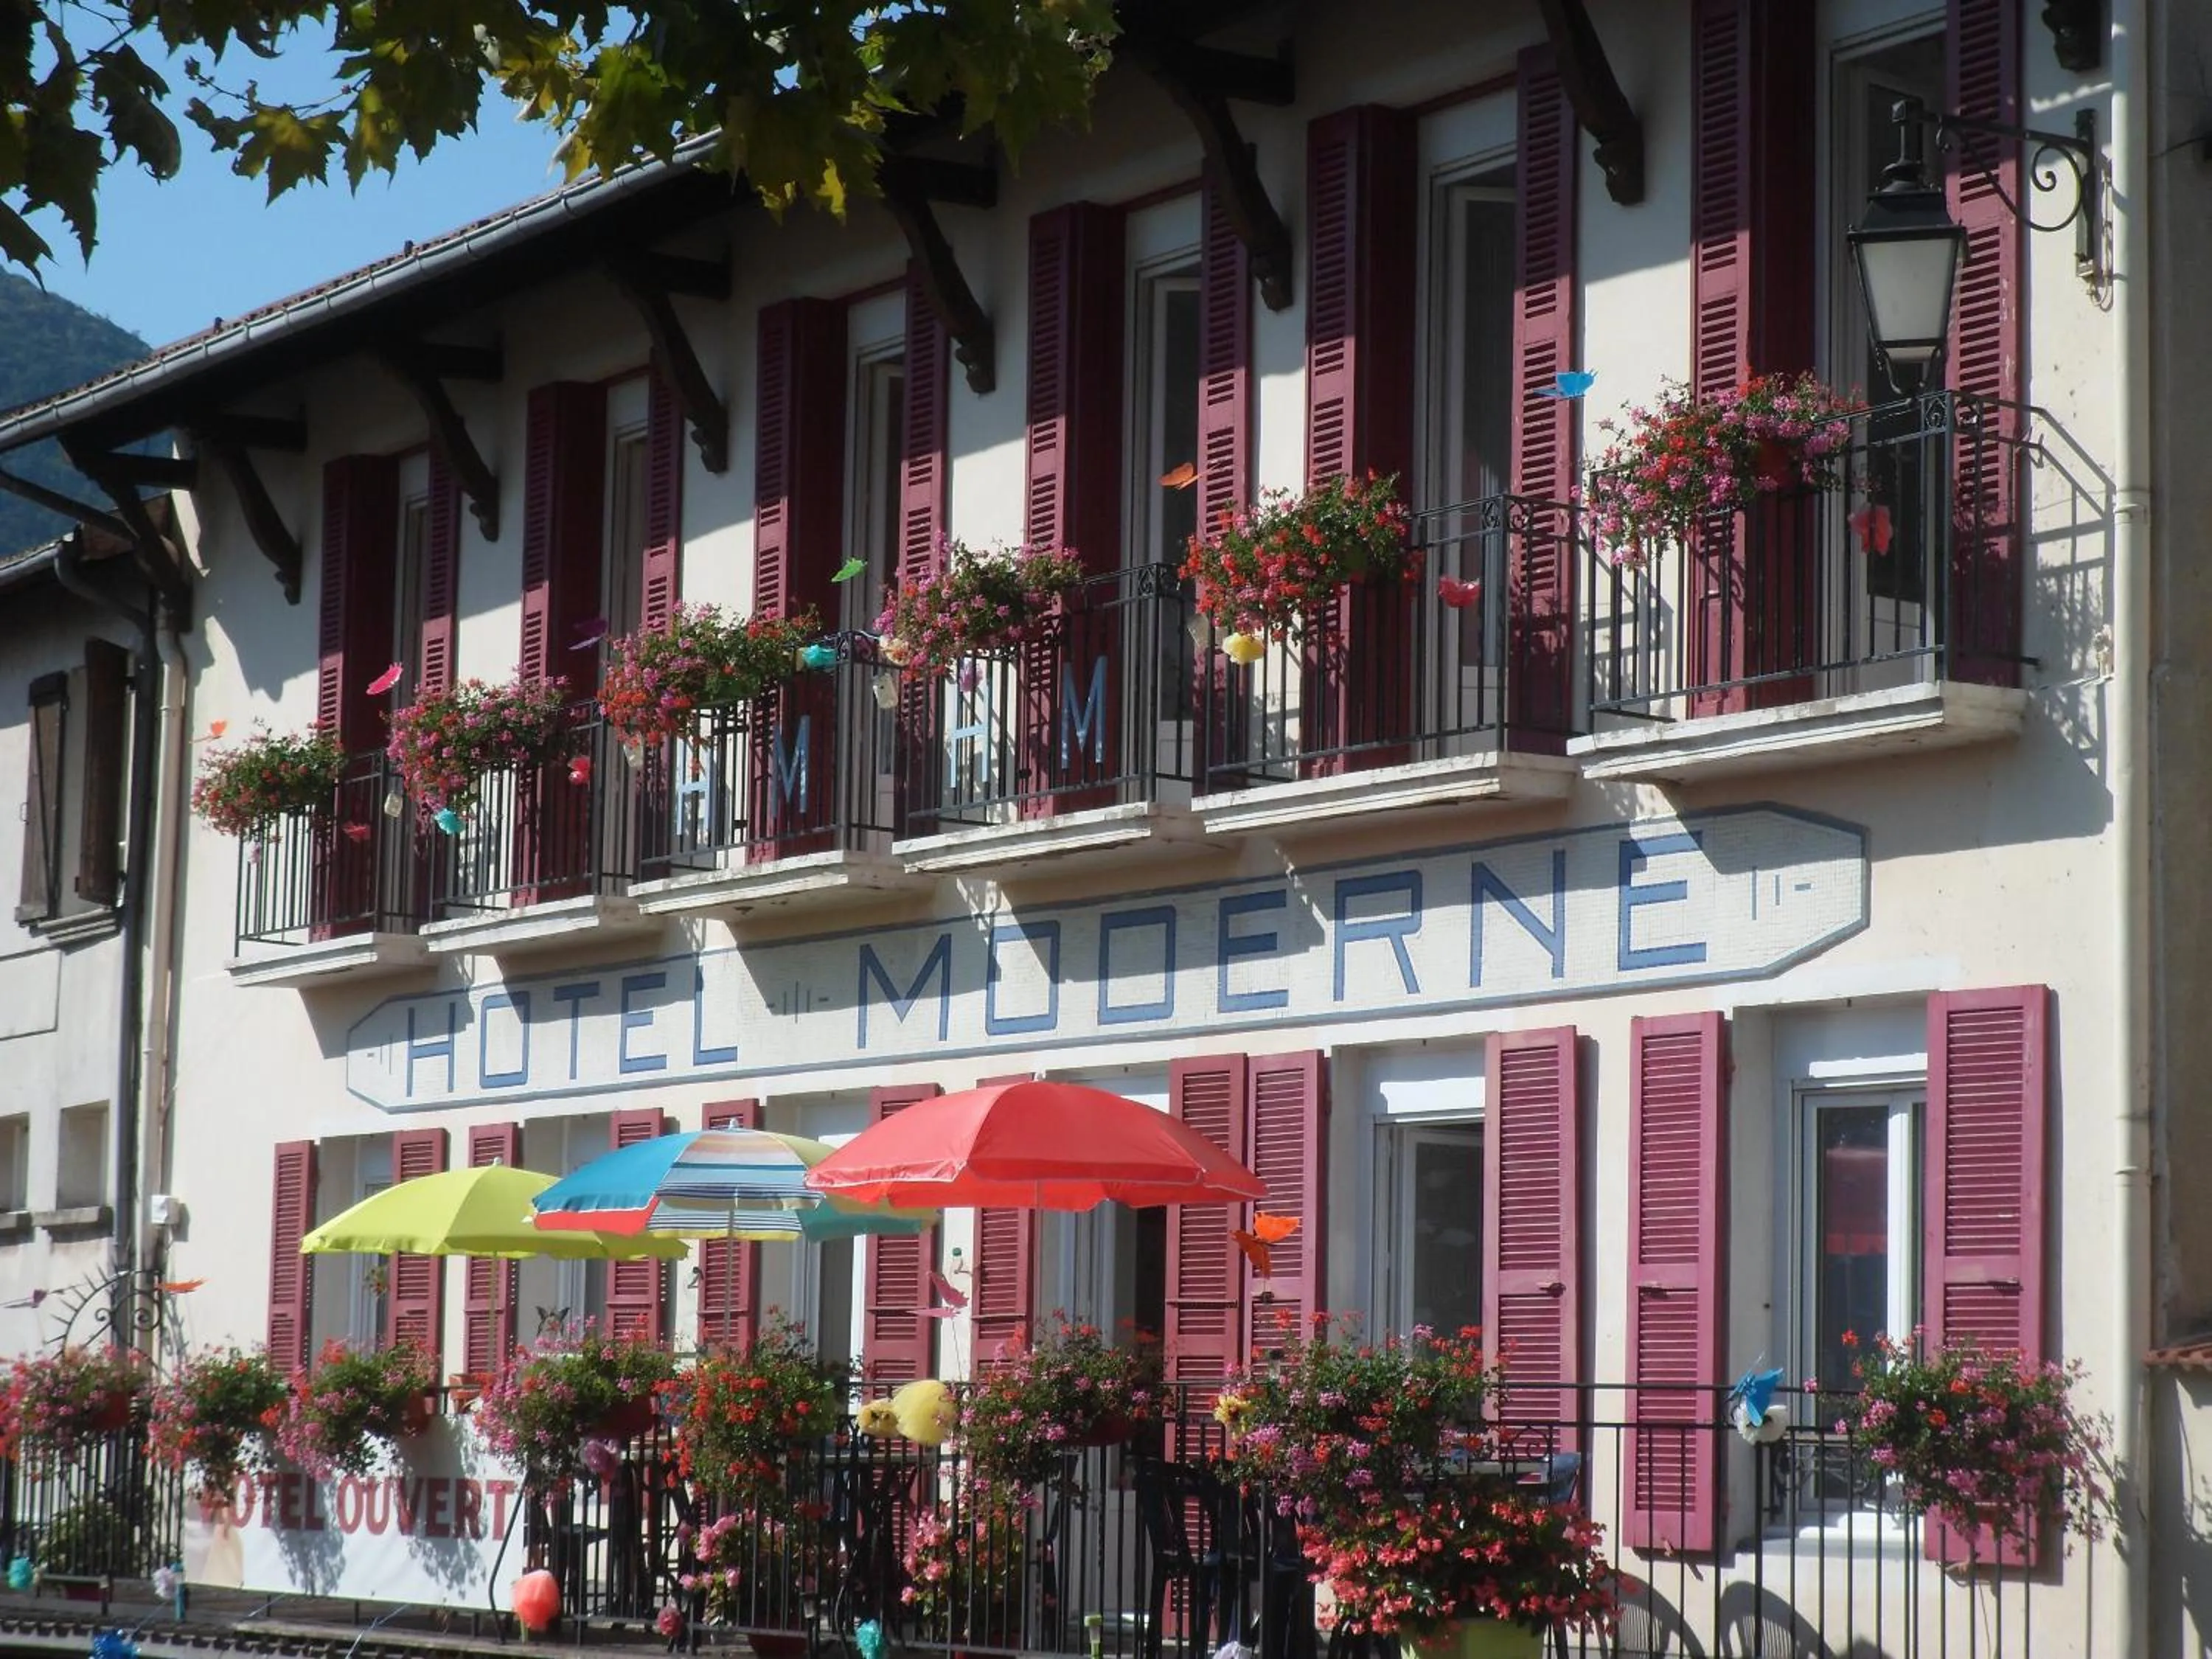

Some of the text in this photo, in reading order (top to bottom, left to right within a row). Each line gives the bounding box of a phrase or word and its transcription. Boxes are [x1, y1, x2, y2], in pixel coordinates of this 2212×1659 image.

[406, 830, 1707, 1097] HOTEL MODERNE
[336, 1474, 515, 1541] OUVERT
